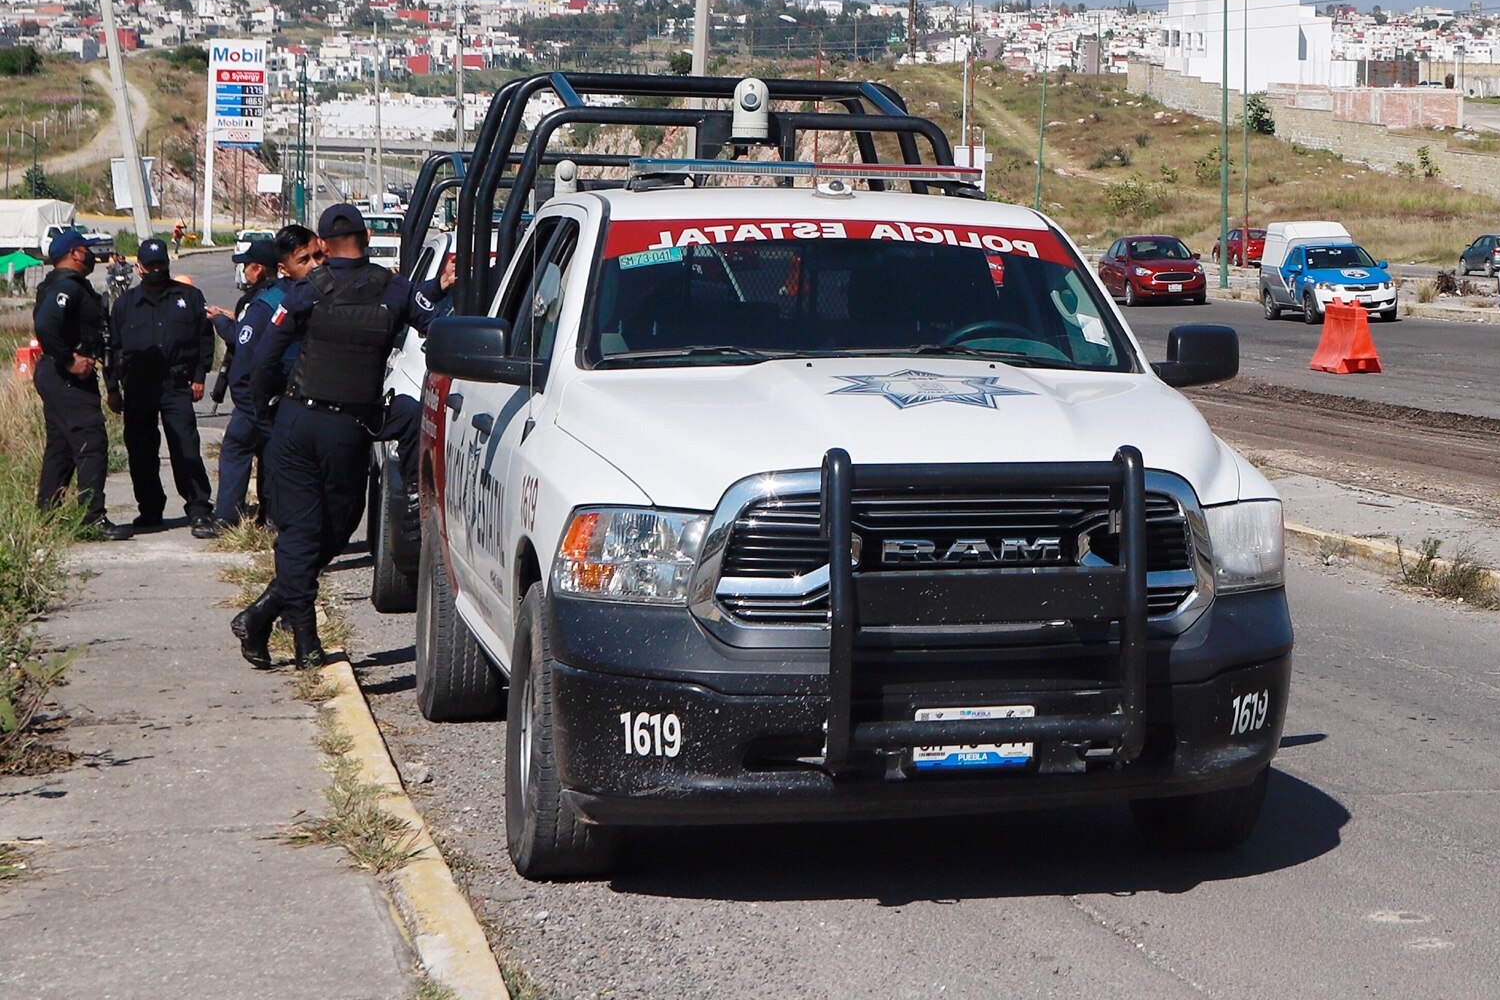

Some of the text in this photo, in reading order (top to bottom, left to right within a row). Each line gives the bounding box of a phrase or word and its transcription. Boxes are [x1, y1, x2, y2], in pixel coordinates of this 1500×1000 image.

[213, 47, 263, 62] Mobil
[231, 72, 260, 82] Synergy
[218, 119, 243, 127] Mobil
[520, 475, 539, 533] 1619
[882, 537, 1061, 564] RAM
[1230, 689, 1269, 736] 1619
[620, 711, 681, 758] 1619
[957, 752, 988, 761] PUEBLA
